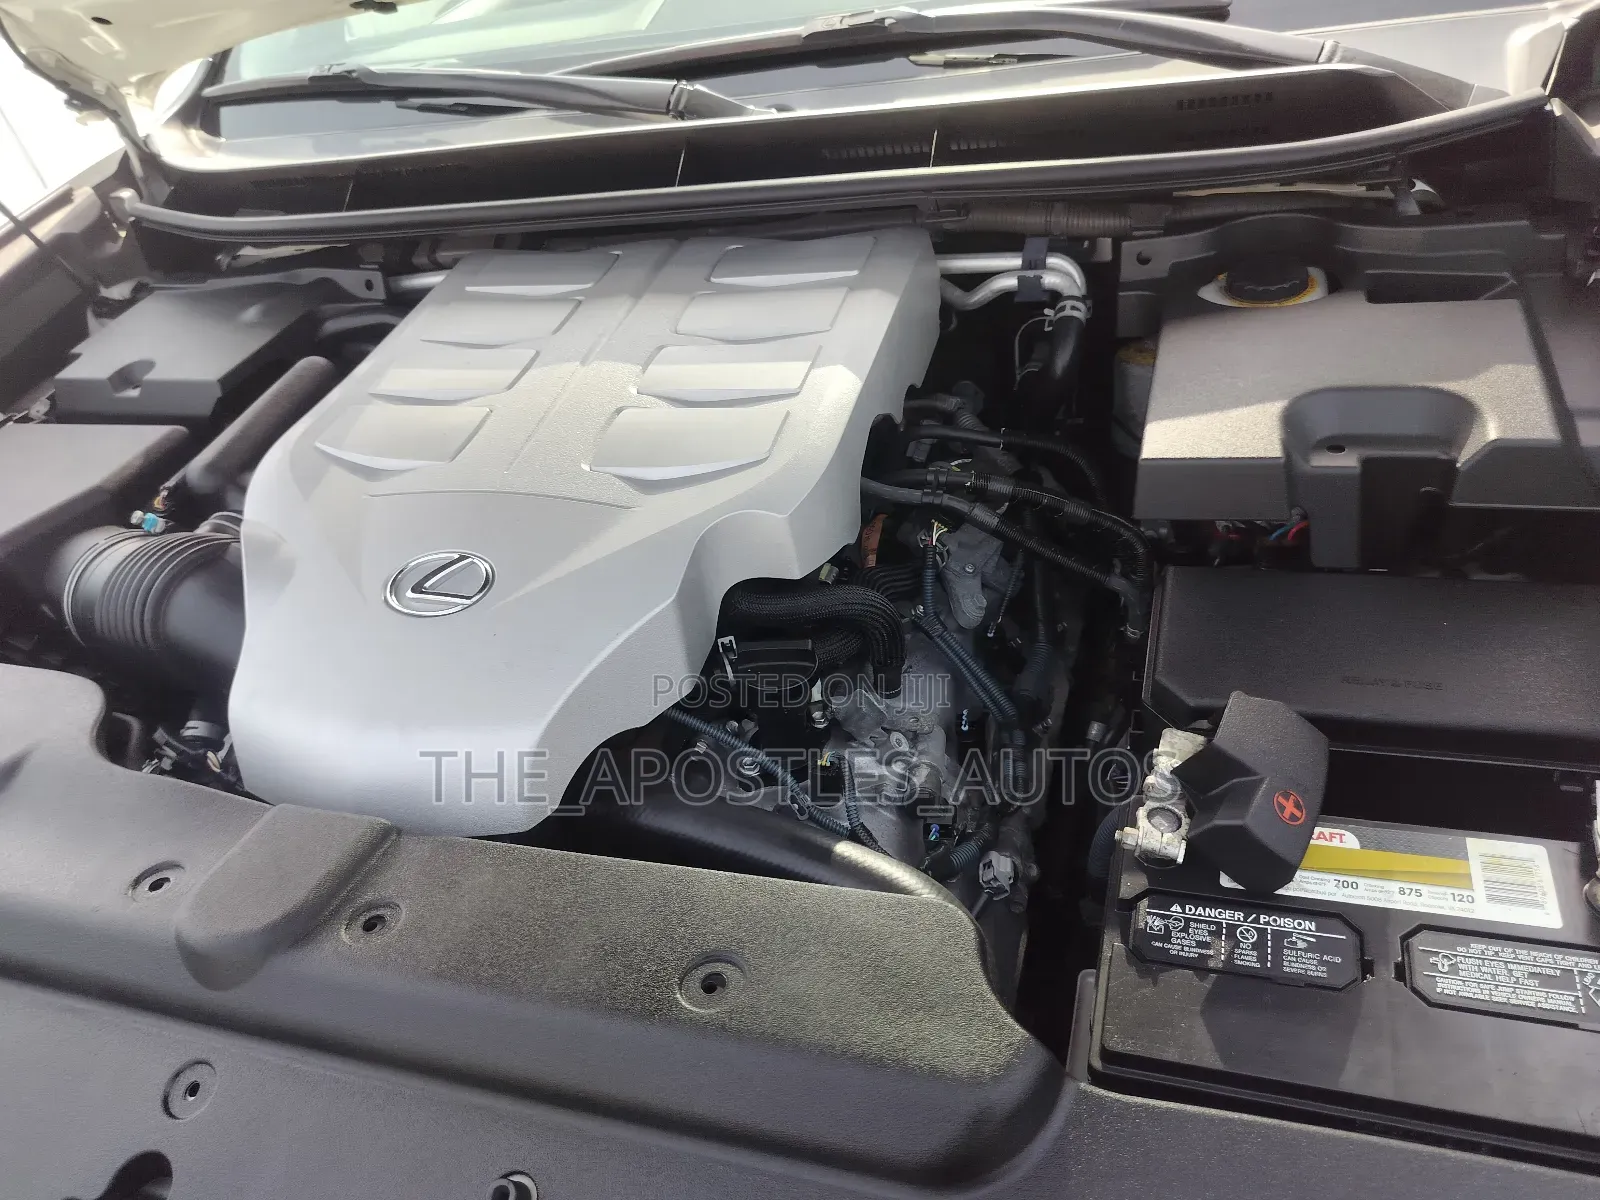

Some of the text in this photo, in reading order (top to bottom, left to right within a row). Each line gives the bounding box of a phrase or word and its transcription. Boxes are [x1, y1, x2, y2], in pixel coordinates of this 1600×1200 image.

[1311, 830, 1346, 843] AFT
[1333, 878, 1359, 890] 700
[1398, 886, 1423, 897] 875
[1450, 892, 1475, 904] 120
[1185, 904, 1244, 922] DANGER
[1260, 914, 1316, 932] POISON
[1188, 927, 1209, 936] EYES
[1189, 921, 1216, 931] SHIELD
[1170, 937, 1196, 947] GASES
[1171, 930, 1212, 943] EXPLOSIVE
[1163, 942, 1182, 950] CAUSE
[1183, 945, 1215, 955] BLINDNESS
[1239, 942, 1252, 950] NO
[1178, 950, 1199, 958] INJURY
[1233, 953, 1258, 962] FLAMES
[1234, 948, 1258, 957] SPARKS
[1282, 948, 1342, 963] SULFURIC ACID
[1468, 947, 1482, 955] NOT
[1498, 951, 1516, 959] KEEP
[1517, 954, 1535, 962] VENT
[1536, 956, 1554, 964] CAPS
[1556, 959, 1576, 968] TIGHT
[1577, 961, 1593, 969] AND
[1529, 950, 1552, 958] REACH
[1233, 959, 1261, 968] SMOKING
[1282, 960, 1316, 971] BLINDNESS
[1456, 956, 1561, 977] FLUSH EYES IMMEDIATELY
[1282, 966, 1328, 978] SEVERE BURNS
[1457, 963, 1480, 973] WITH
[1512, 970, 1529, 979] GET
[1458, 970, 1540, 987] MEDICAL HELP FAST
[1436, 982, 1481, 994] INSTRUCTIONS
[1491, 989, 1517, 998] VEHICLE
[1465, 980, 1478, 988] FOR
[1479, 982, 1496, 990] SAFE
[1496, 985, 1514, 993] JUMP
[1516, 987, 1548, 997] STARTING
[1548, 992, 1575, 1001] FOLLOW
[1443, 988, 1457, 996] NOT
[1458, 990, 1490, 1001] AVAILABLE
[1491, 994, 1508, 1003] SEEK
[1509, 997, 1536, 1008] SERVICE
